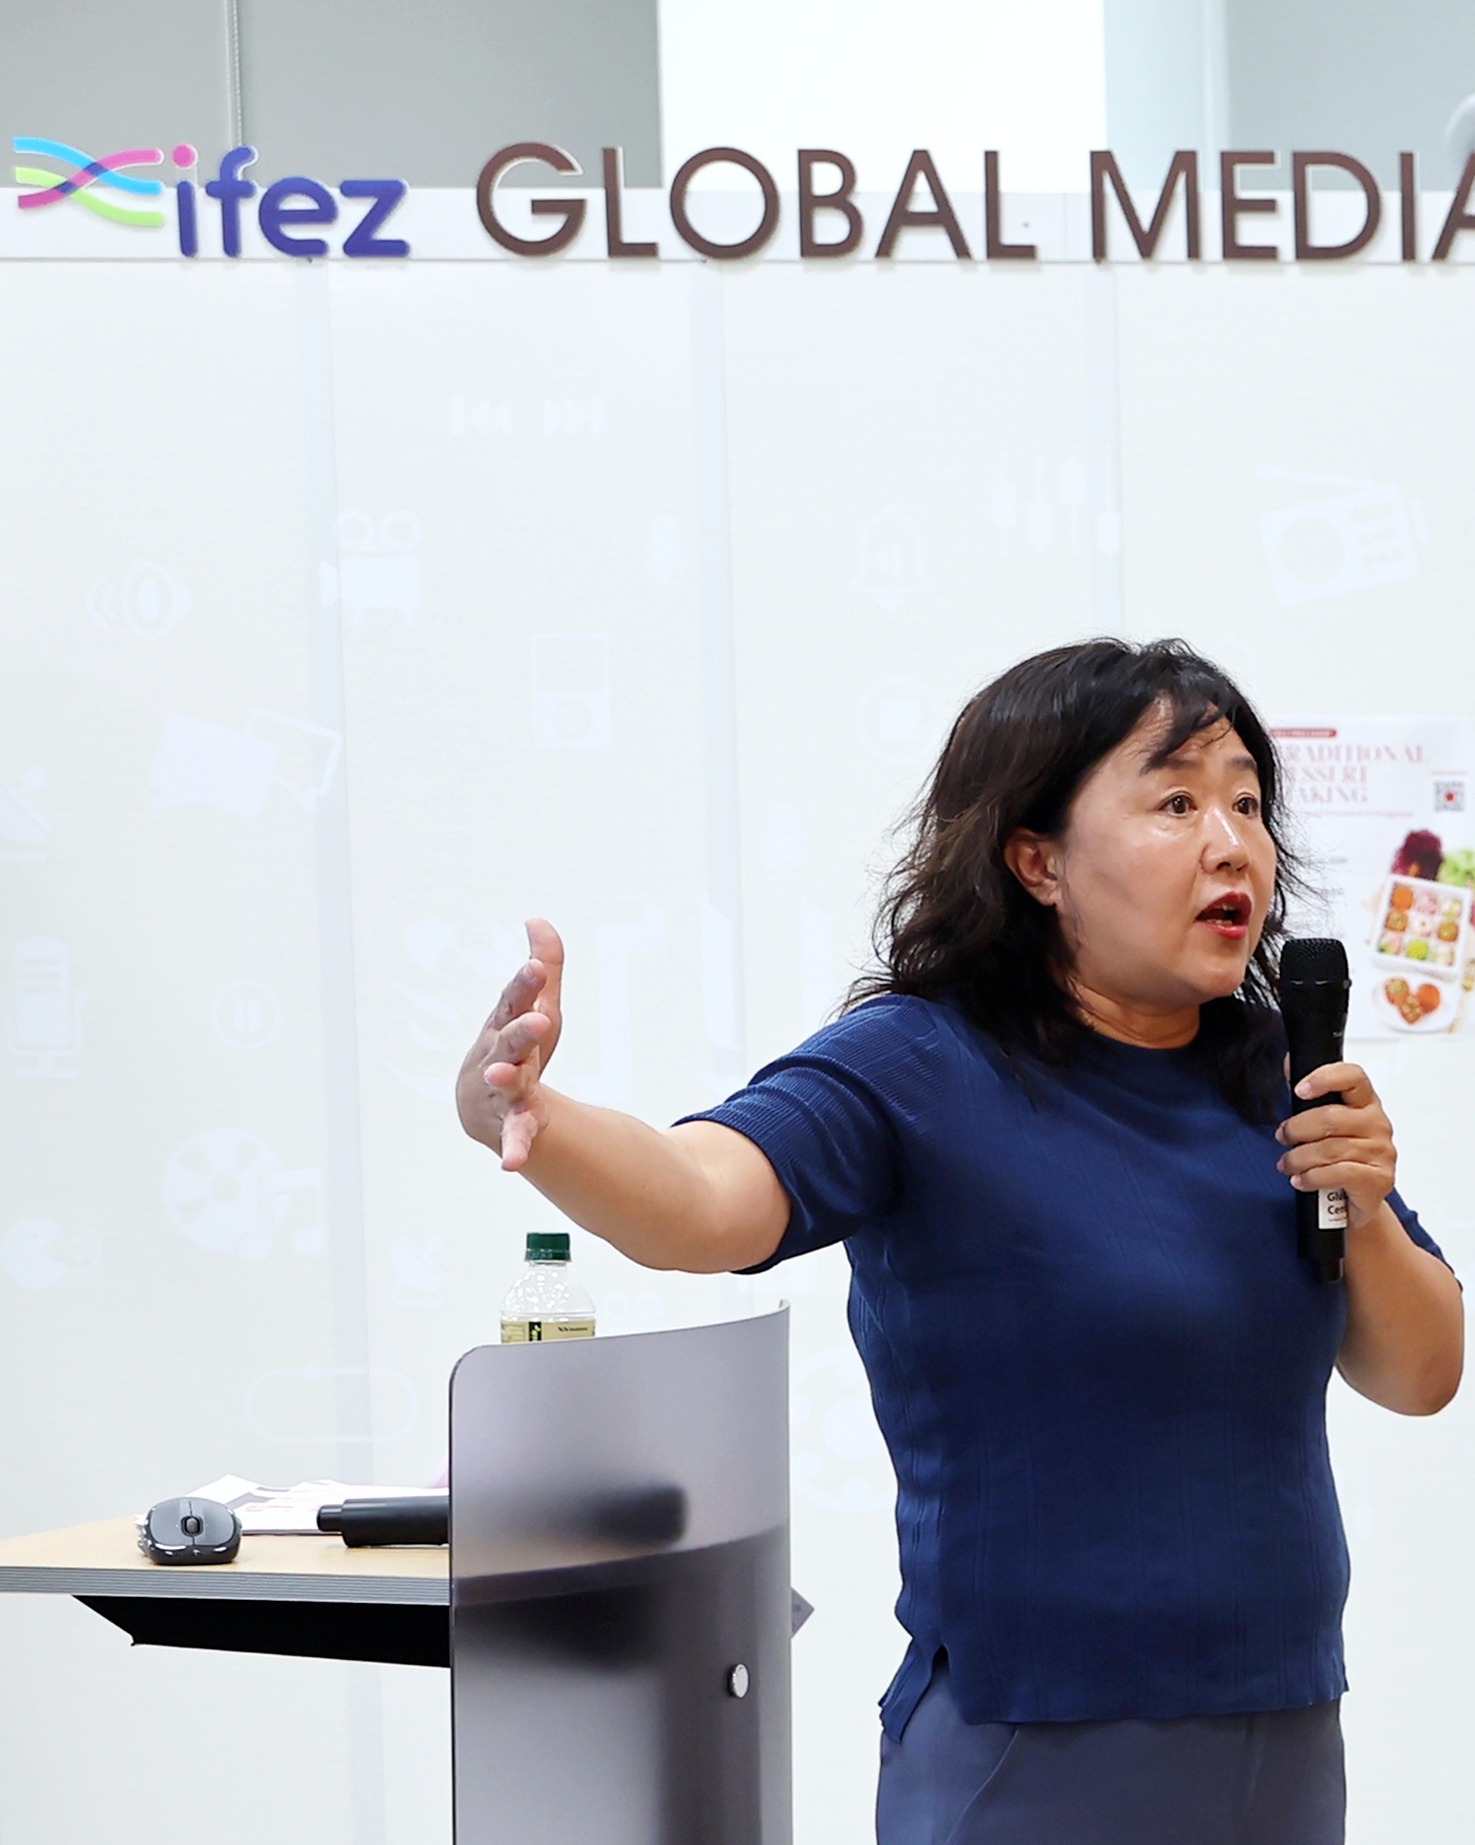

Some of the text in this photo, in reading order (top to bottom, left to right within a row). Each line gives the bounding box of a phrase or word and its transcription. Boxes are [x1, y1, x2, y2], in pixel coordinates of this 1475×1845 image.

[172, 143, 411, 258] ifez
[475, 141, 1037, 260] GLOBAL
[1278, 743, 1429, 763] RADITIONAL
[1280, 765, 1369, 784] ESSERT
